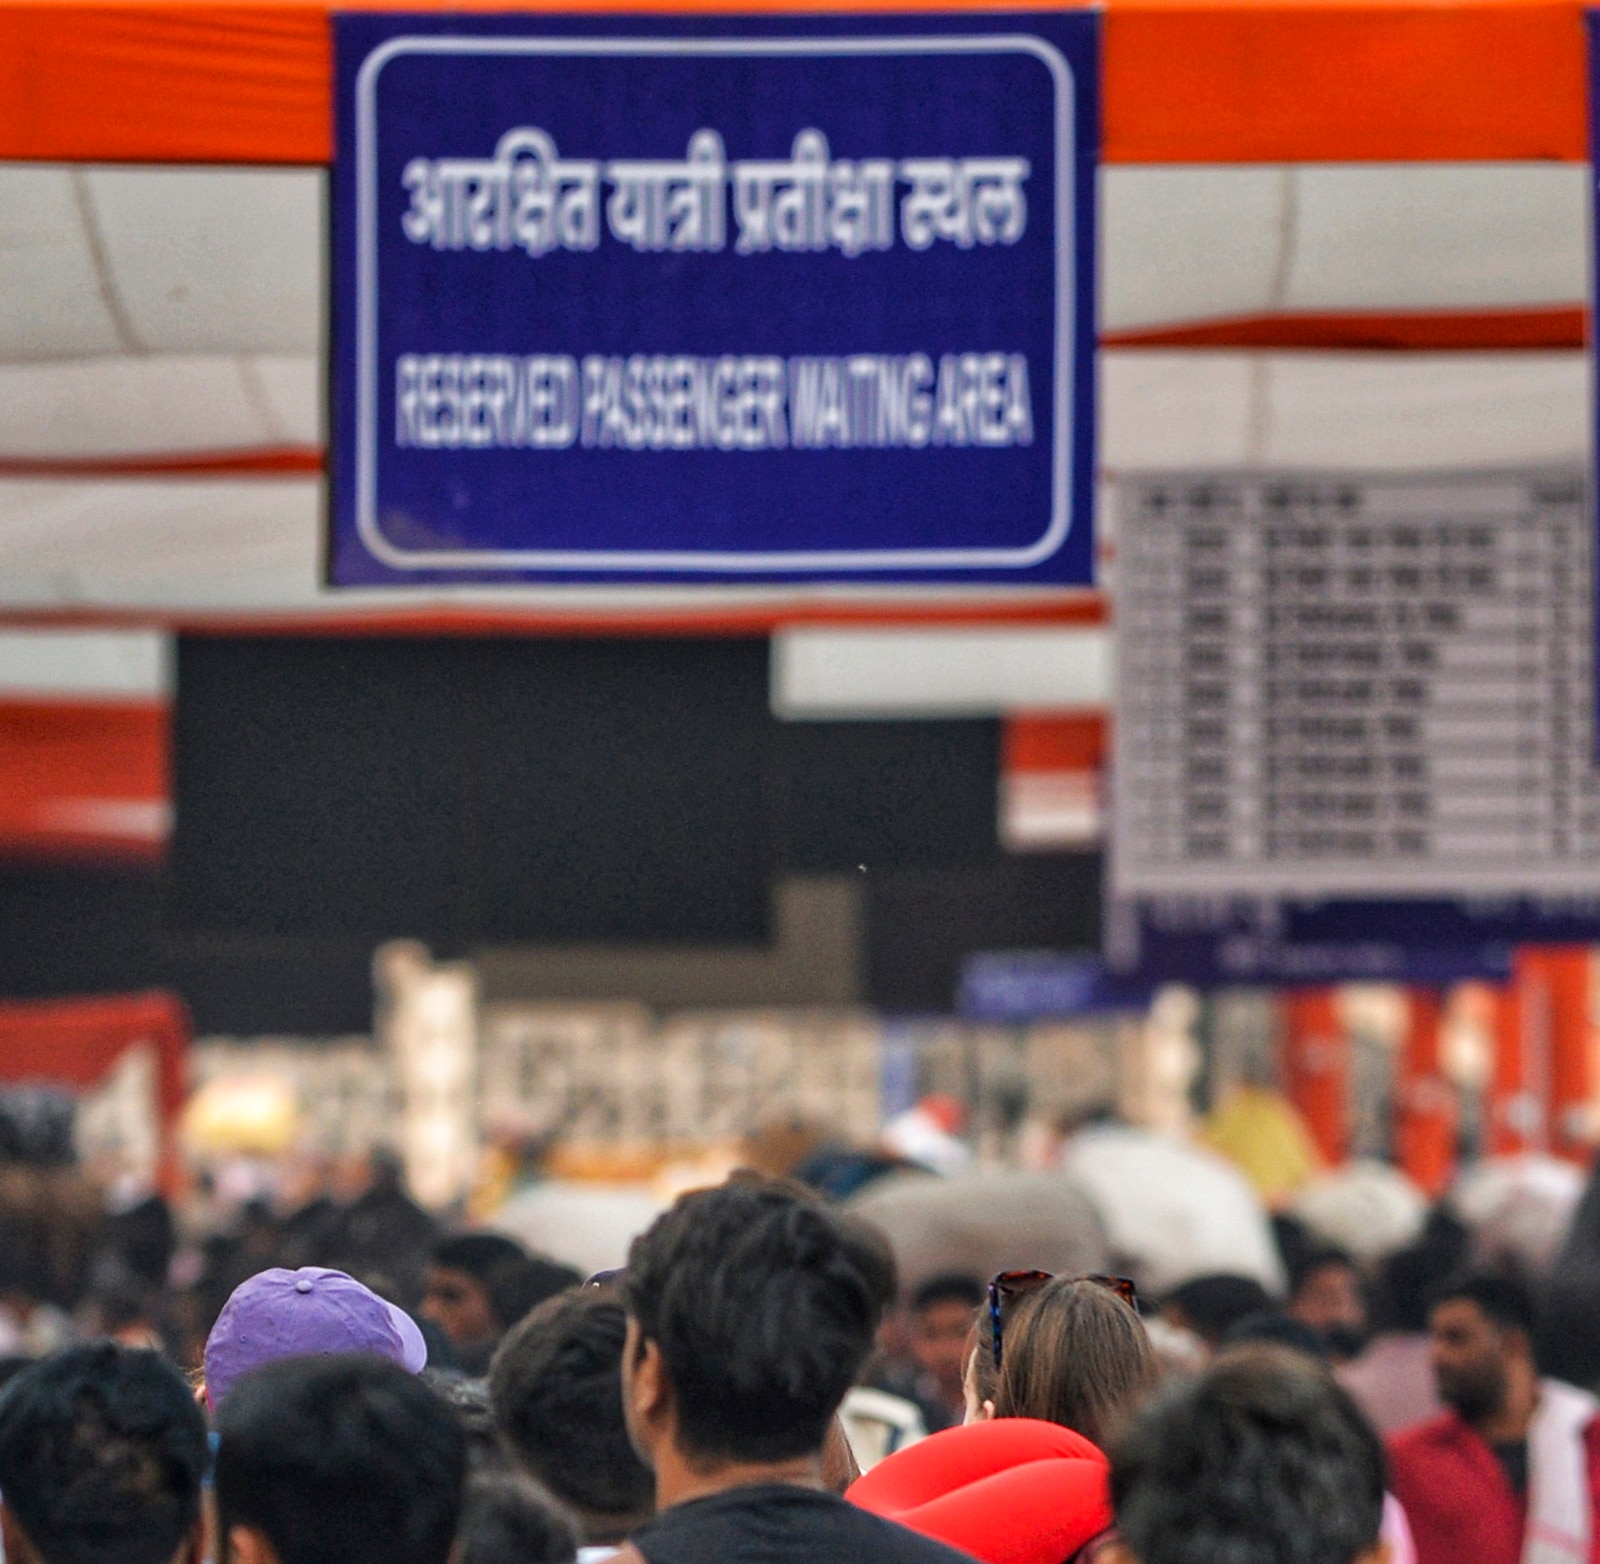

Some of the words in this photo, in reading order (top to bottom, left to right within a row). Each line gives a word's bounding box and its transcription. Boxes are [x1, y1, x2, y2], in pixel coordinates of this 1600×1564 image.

[403, 127, 599, 258] आरक्षित
[606, 127, 726, 252] यात्री
[733, 127, 894, 258] प्रतीक्षा
[901, 157, 1031, 251] स्थल
[396, 354, 580, 448] RESERVED
[580, 354, 787, 450] PASSENGER
[932, 352, 1036, 448] AREA
